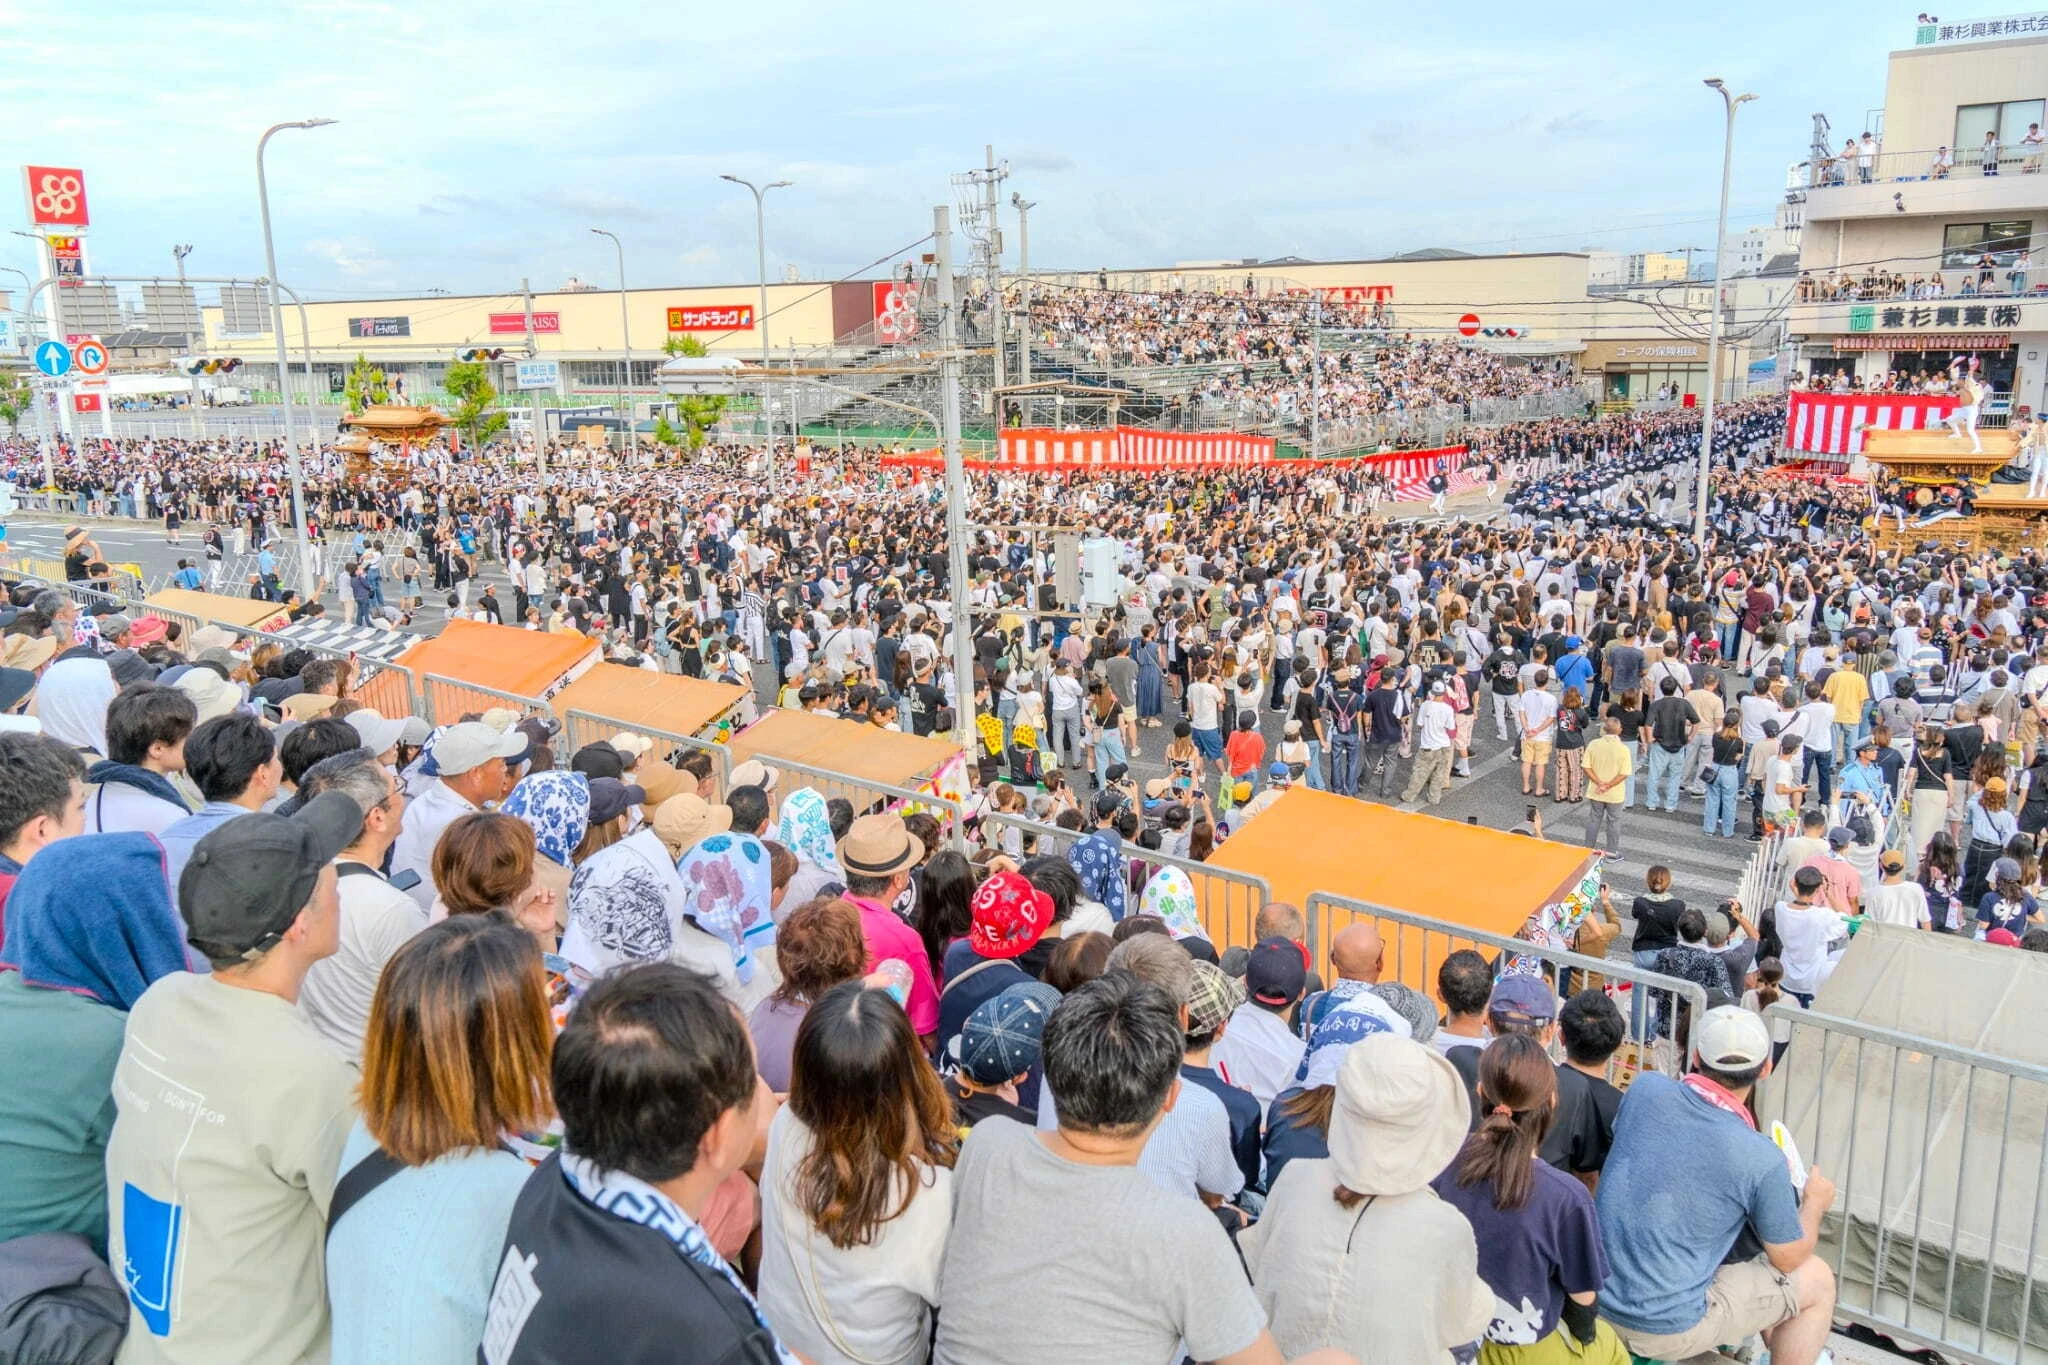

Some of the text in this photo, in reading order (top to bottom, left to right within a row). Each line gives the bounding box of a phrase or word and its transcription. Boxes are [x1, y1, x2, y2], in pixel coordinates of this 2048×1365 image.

[683, 309, 739, 327] サンドラッグ
[82, 397, 91, 409] P
[200, 1107, 226, 1125] FOR
